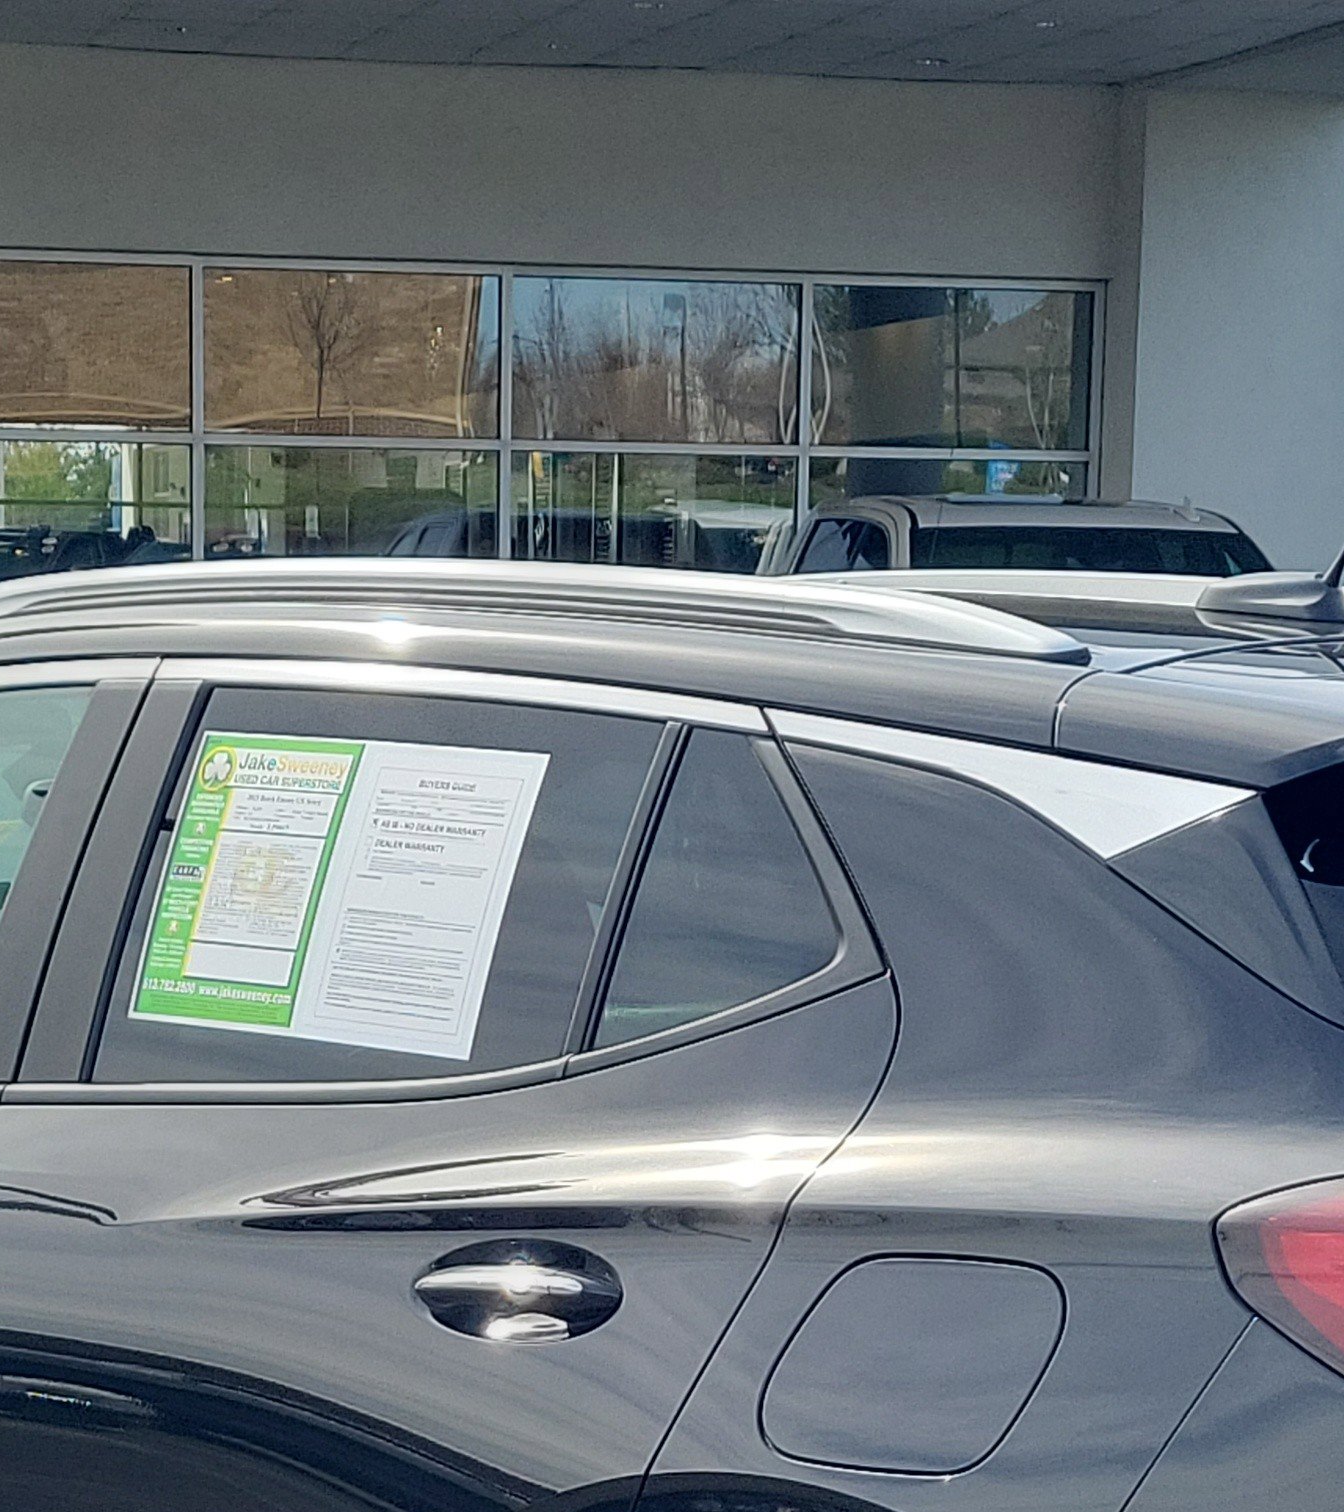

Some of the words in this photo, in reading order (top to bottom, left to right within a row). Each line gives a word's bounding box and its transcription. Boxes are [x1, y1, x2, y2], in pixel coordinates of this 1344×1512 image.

[234, 774, 258, 785] USED
[260, 776, 279, 787] CAR
[280, 776, 341, 790] SUPERSTORE
[404, 821, 414, 831] NO
[416, 822, 445, 834] DEALER
[375, 838, 403, 848] DEALER
